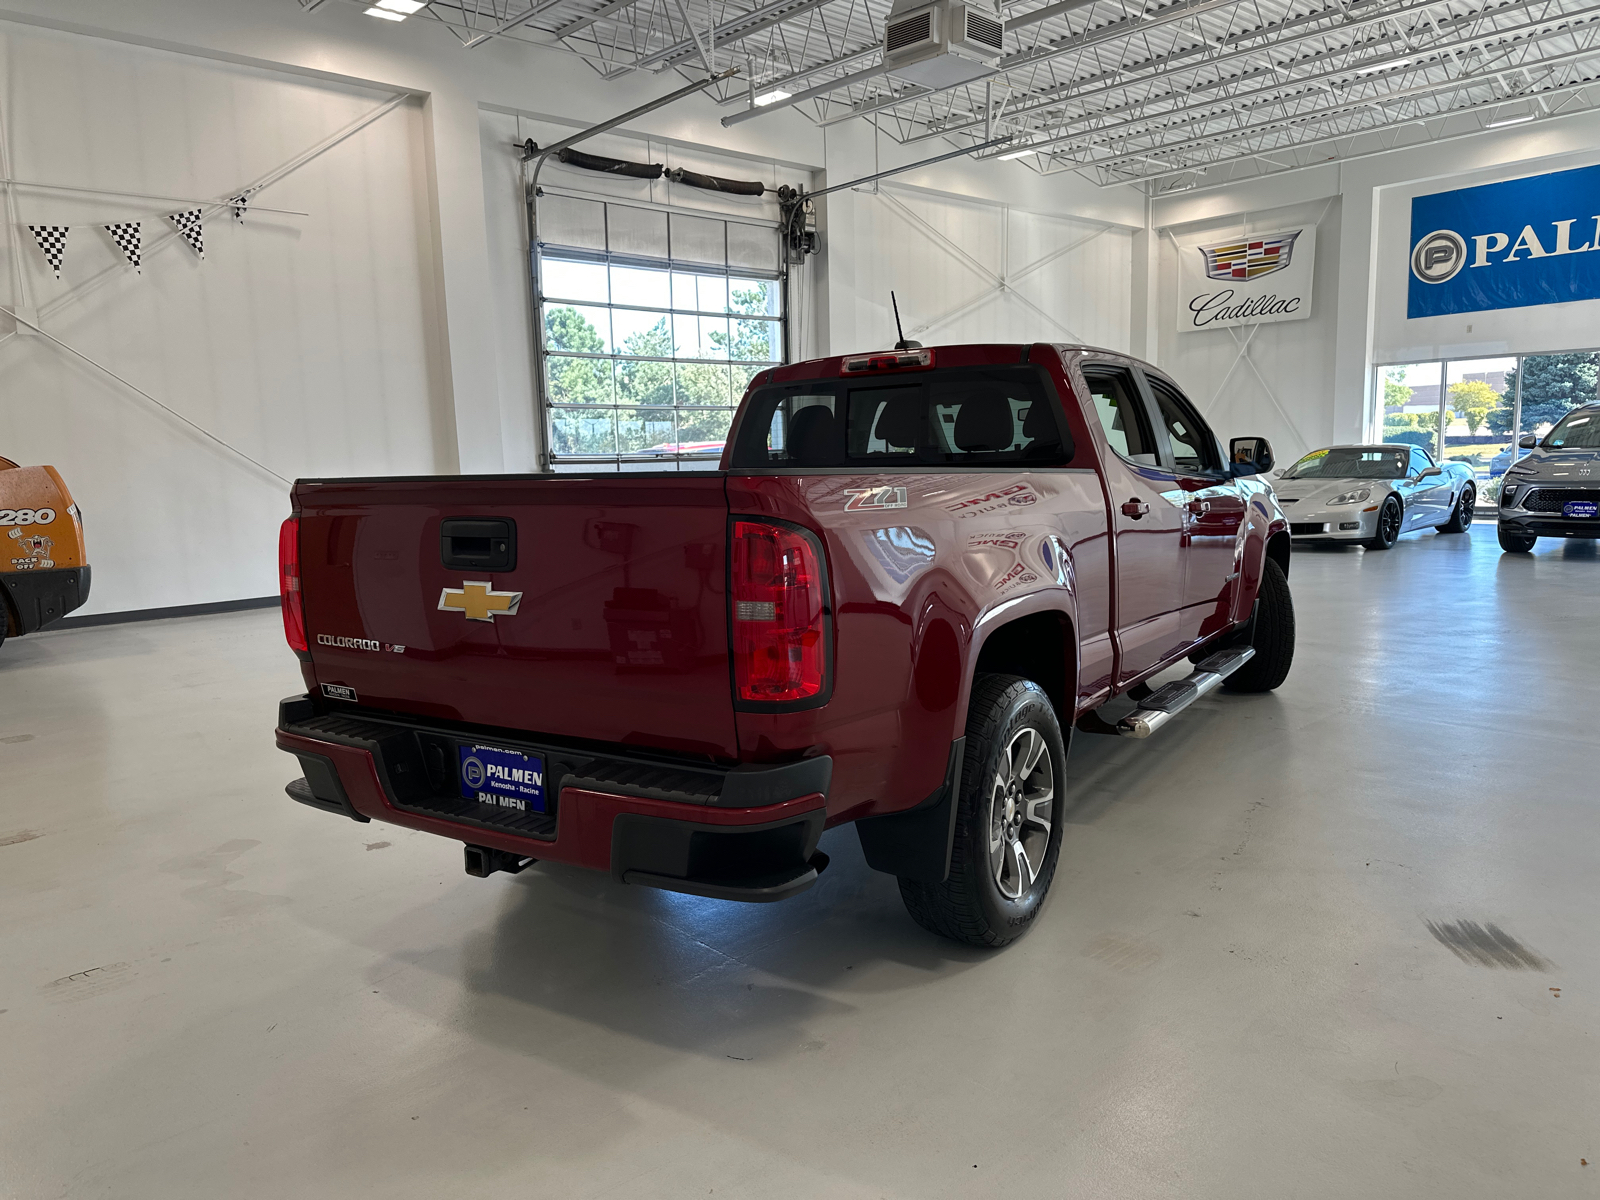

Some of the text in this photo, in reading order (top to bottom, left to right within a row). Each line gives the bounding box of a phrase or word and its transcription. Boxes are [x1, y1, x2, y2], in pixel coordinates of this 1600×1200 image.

[1470, 215, 1600, 268] PAL
[1189, 289, 1301, 326] Cadillac
[843, 486, 908, 512] Z71
[317, 633, 380, 652] COLORADO
[327, 685, 350, 696] PALMEN
[475, 744, 522, 755] palmen.com
[487, 764, 542, 786] PALMEN
[490, 780, 516, 791] Kenosha
[519, 785, 540, 796] Racine
